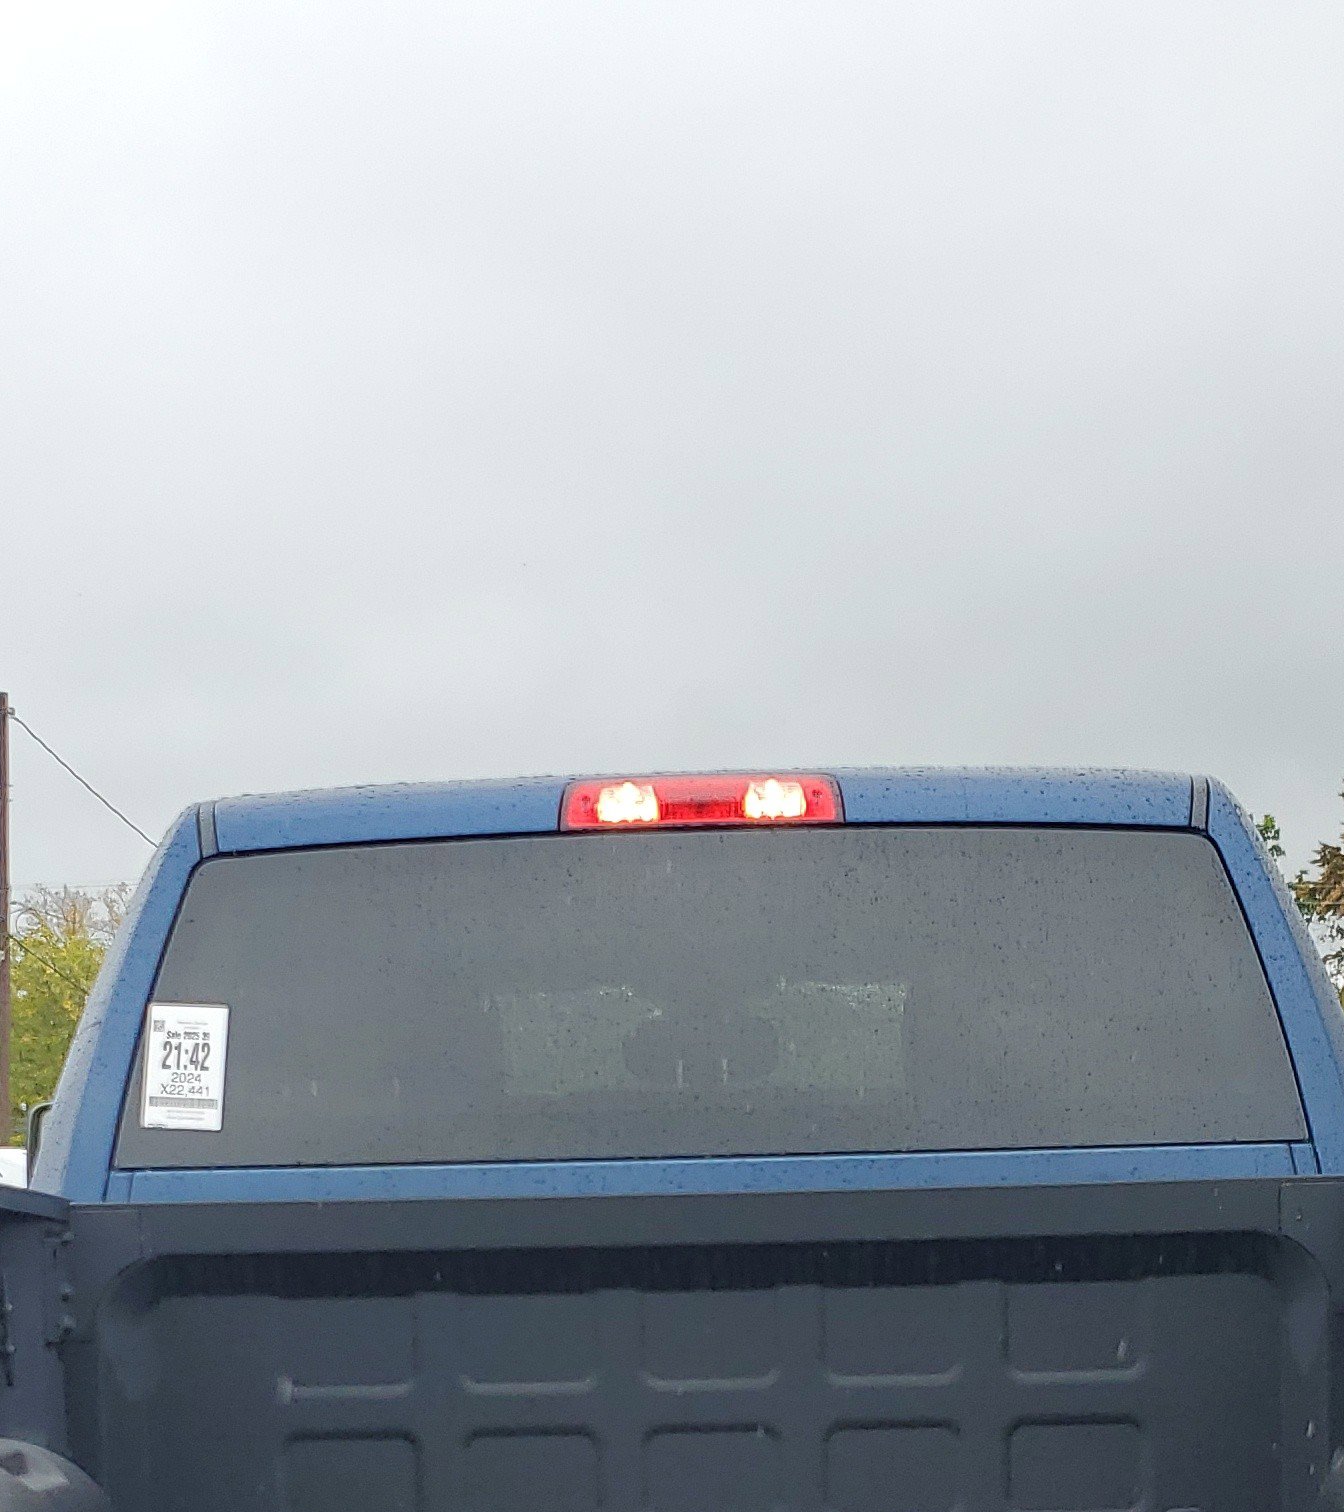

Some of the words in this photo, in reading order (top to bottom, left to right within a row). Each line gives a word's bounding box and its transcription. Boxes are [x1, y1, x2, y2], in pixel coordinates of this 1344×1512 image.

[161, 1041, 211, 1072] 21:42
[171, 1072, 202, 1084] 2024
[160, 1083, 210, 1097] X22,441
